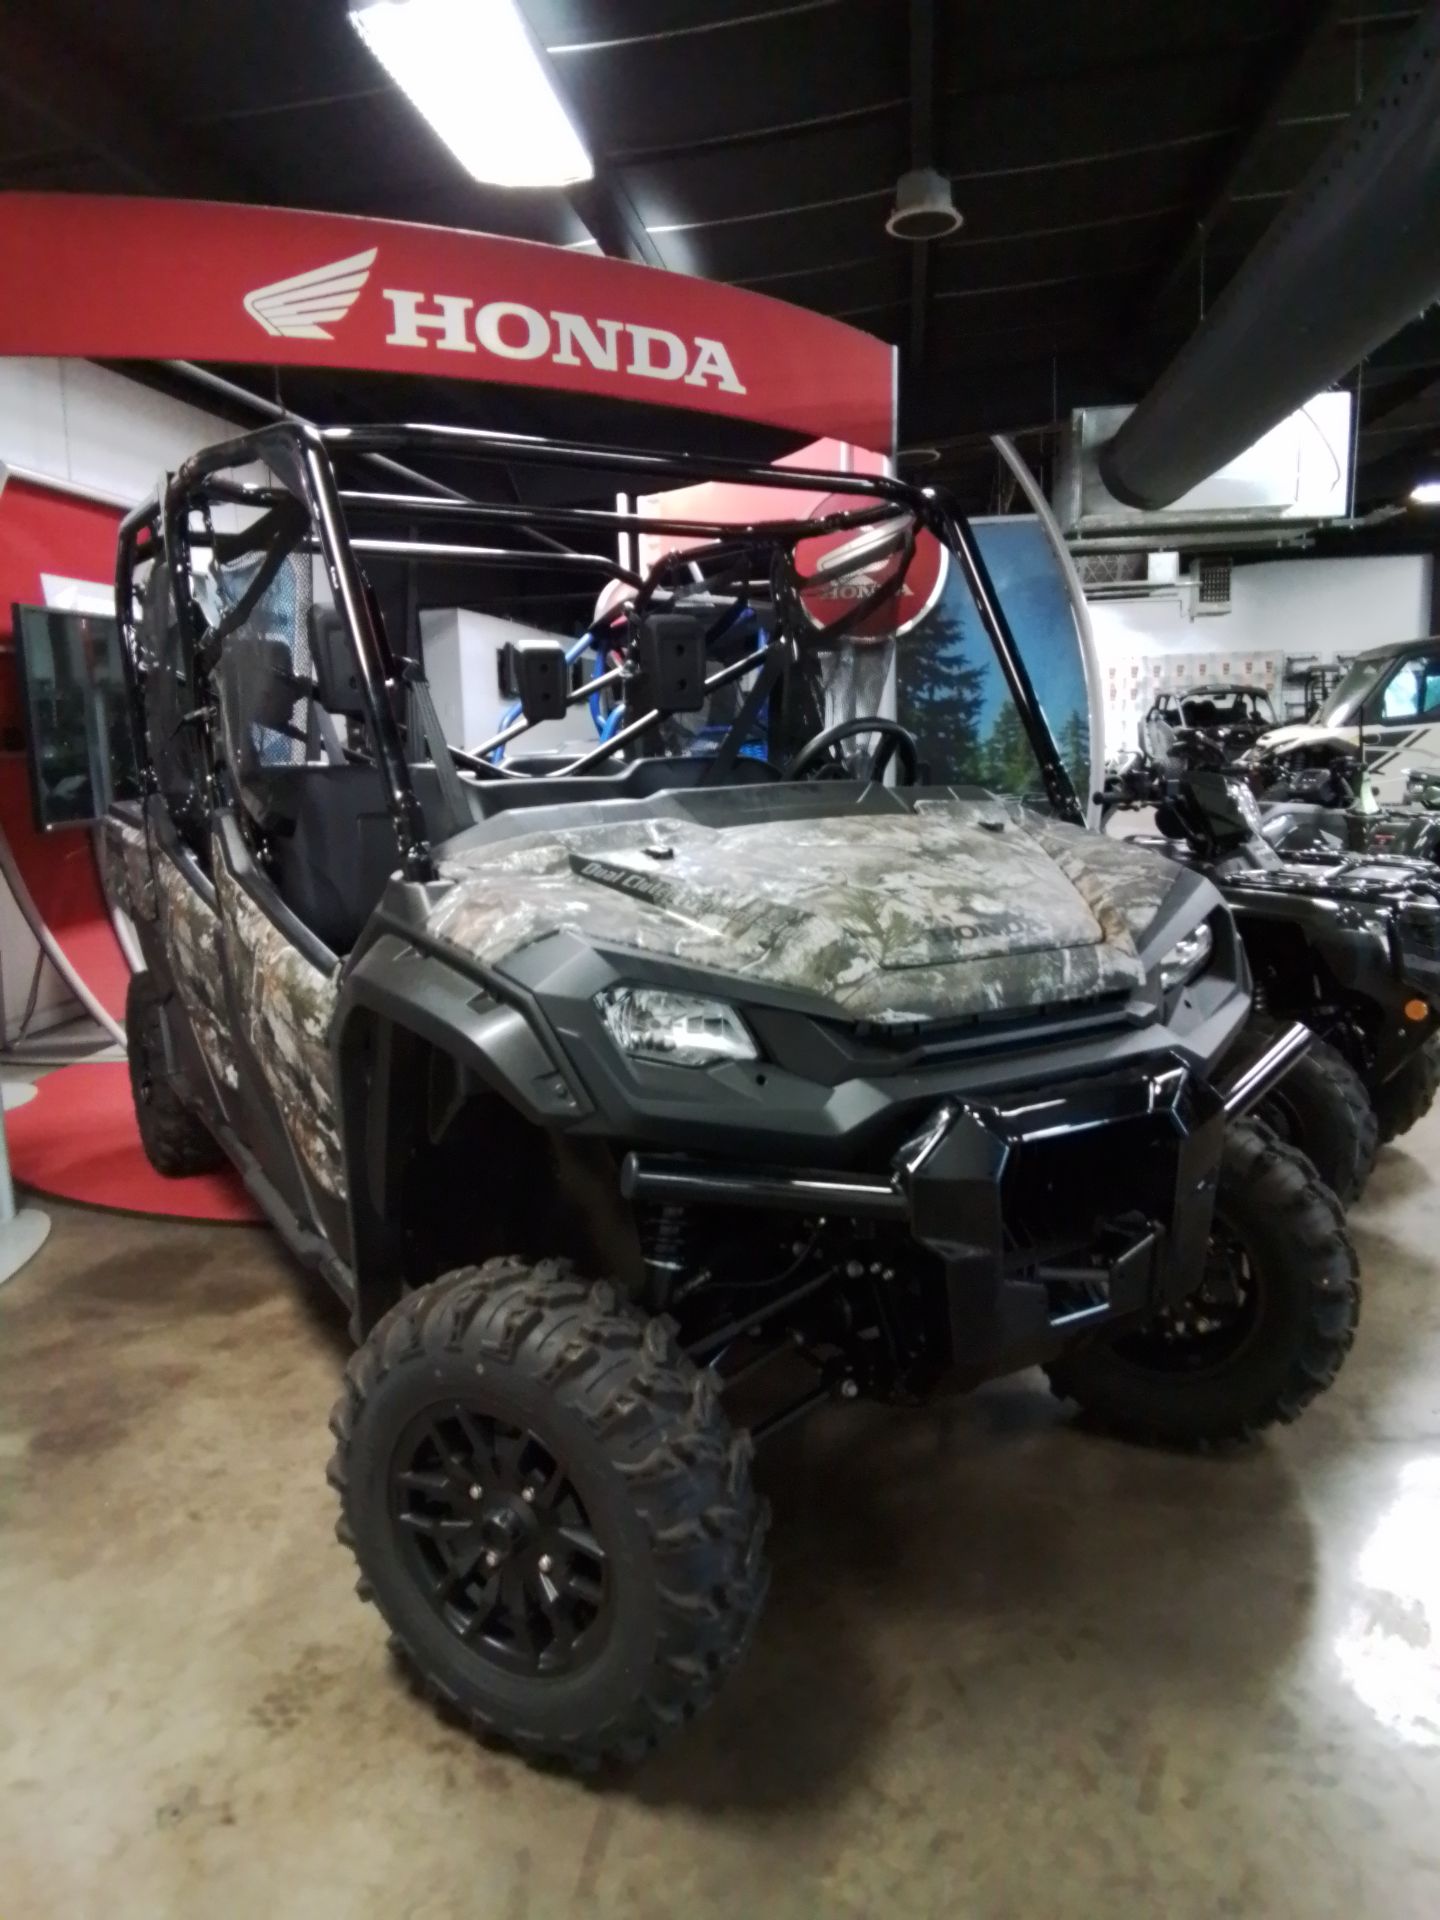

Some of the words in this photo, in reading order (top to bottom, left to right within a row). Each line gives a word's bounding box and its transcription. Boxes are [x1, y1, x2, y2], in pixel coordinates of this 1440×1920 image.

[383, 289, 747, 395] HONDA
[820, 581, 914, 599] HONA
[581, 862, 621, 883] Dual
